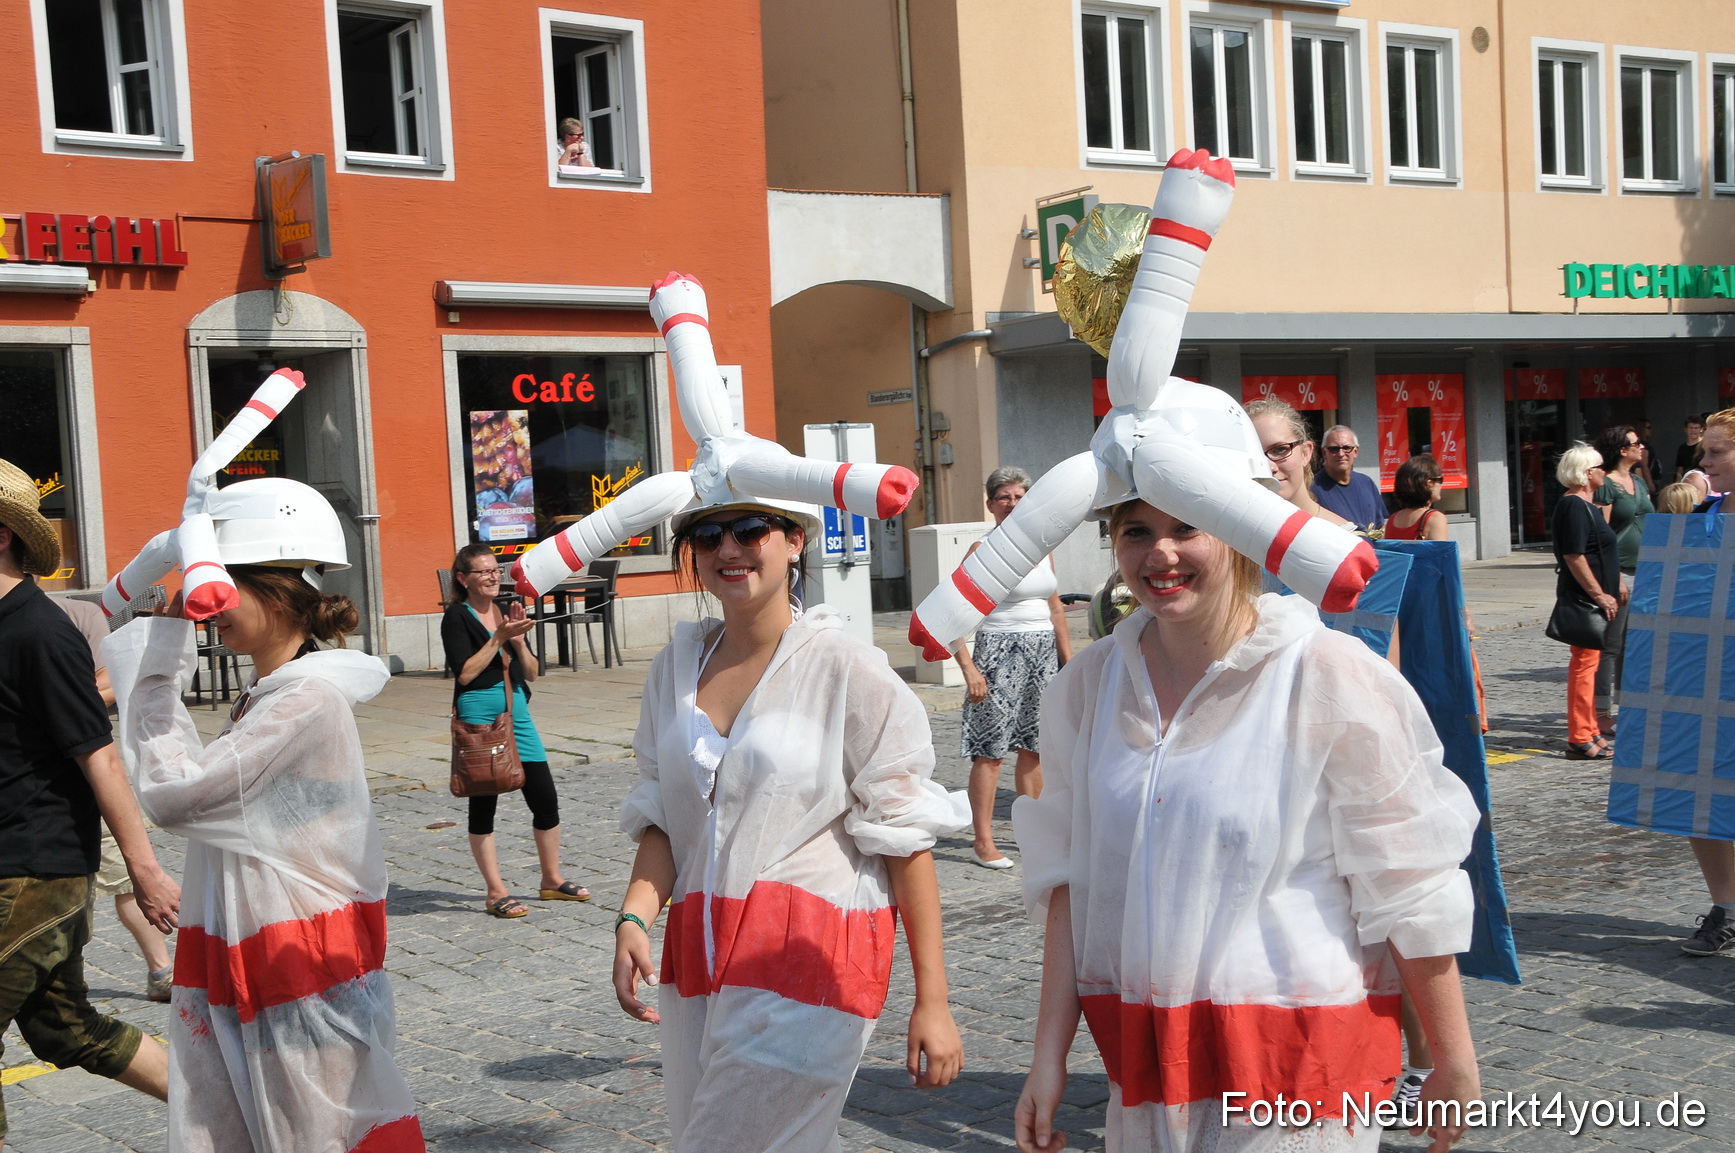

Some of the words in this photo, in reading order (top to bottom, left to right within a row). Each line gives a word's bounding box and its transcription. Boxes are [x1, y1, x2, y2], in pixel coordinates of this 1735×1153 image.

[280, 209, 296, 226] DER
[511, 372, 595, 403] Café
[1386, 431, 1394, 447] 1
[1383, 457, 1401, 466] gratis
